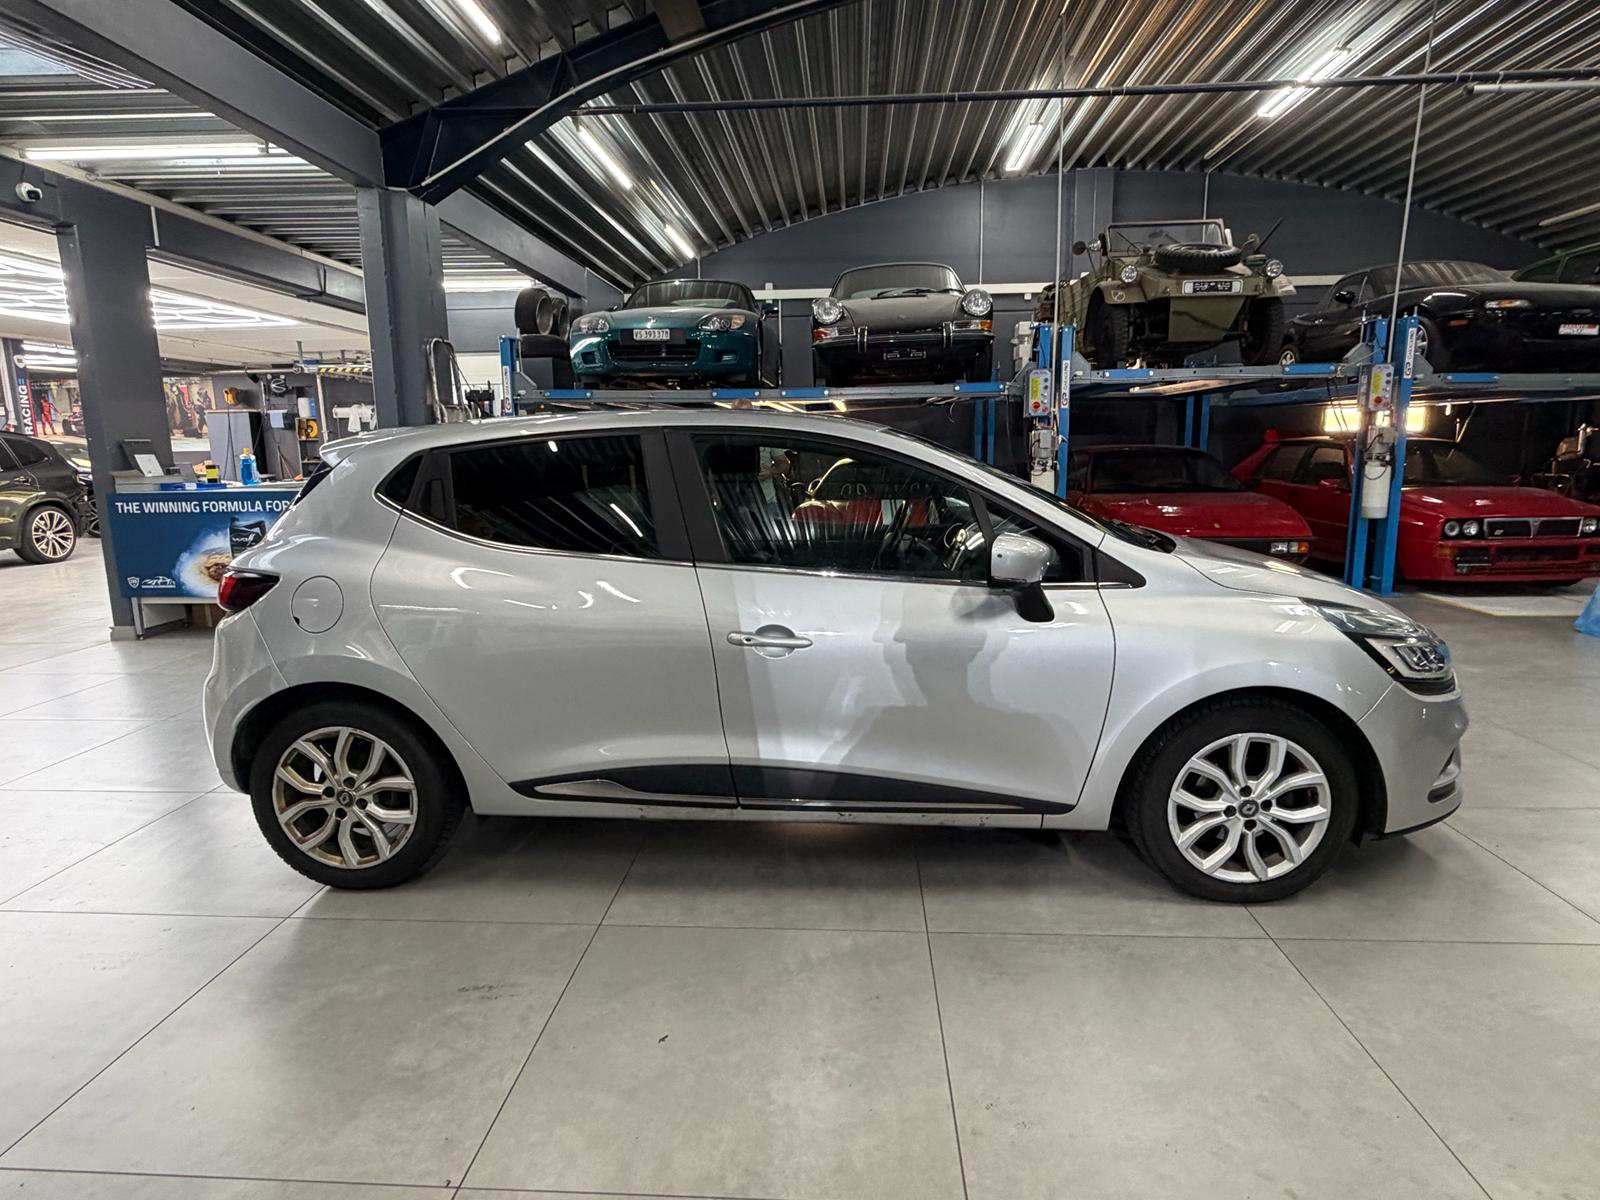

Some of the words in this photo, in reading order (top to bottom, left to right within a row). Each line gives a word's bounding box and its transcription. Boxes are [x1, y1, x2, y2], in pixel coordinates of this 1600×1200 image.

[19, 385, 34, 434] RACING
[116, 502, 141, 513] THE
[142, 501, 199, 513] WINNING
[203, 501, 263, 512] FORMULA
